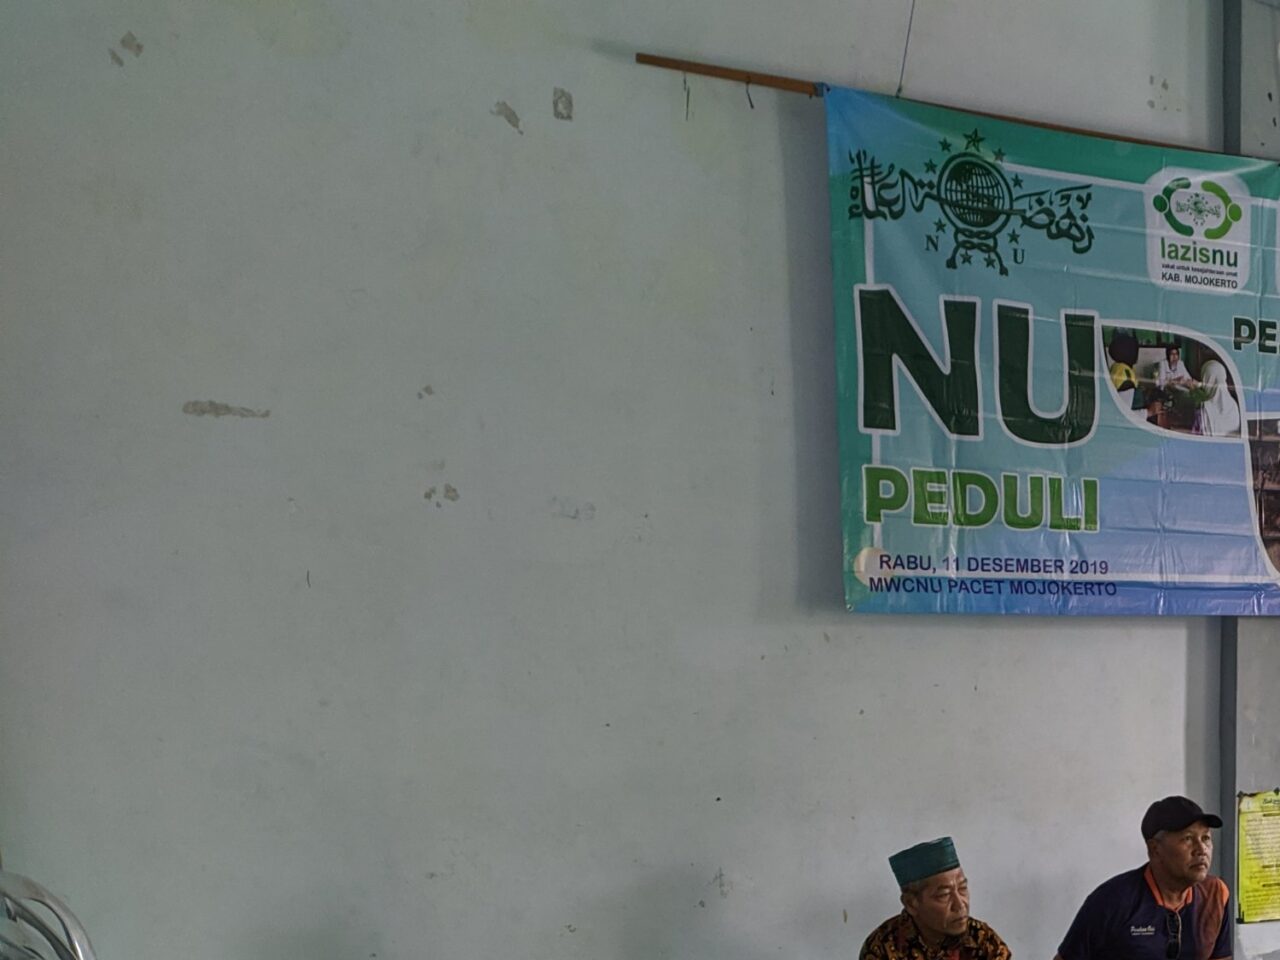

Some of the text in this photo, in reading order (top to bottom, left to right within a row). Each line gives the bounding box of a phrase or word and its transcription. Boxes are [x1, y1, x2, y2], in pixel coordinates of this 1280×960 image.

[925, 234, 1025, 265] N U
[1161, 237, 1238, 268] lazisnu
[1162, 272, 1238, 289] KAB. MOJOKERTO
[855, 285, 1098, 448] NU
[862, 465, 1099, 532] PEDULI
[880, 554, 1109, 574] RABU, 11 DESEMBER 2019
[869, 576, 1117, 596] MWCNU PACET MOJOKERTO
